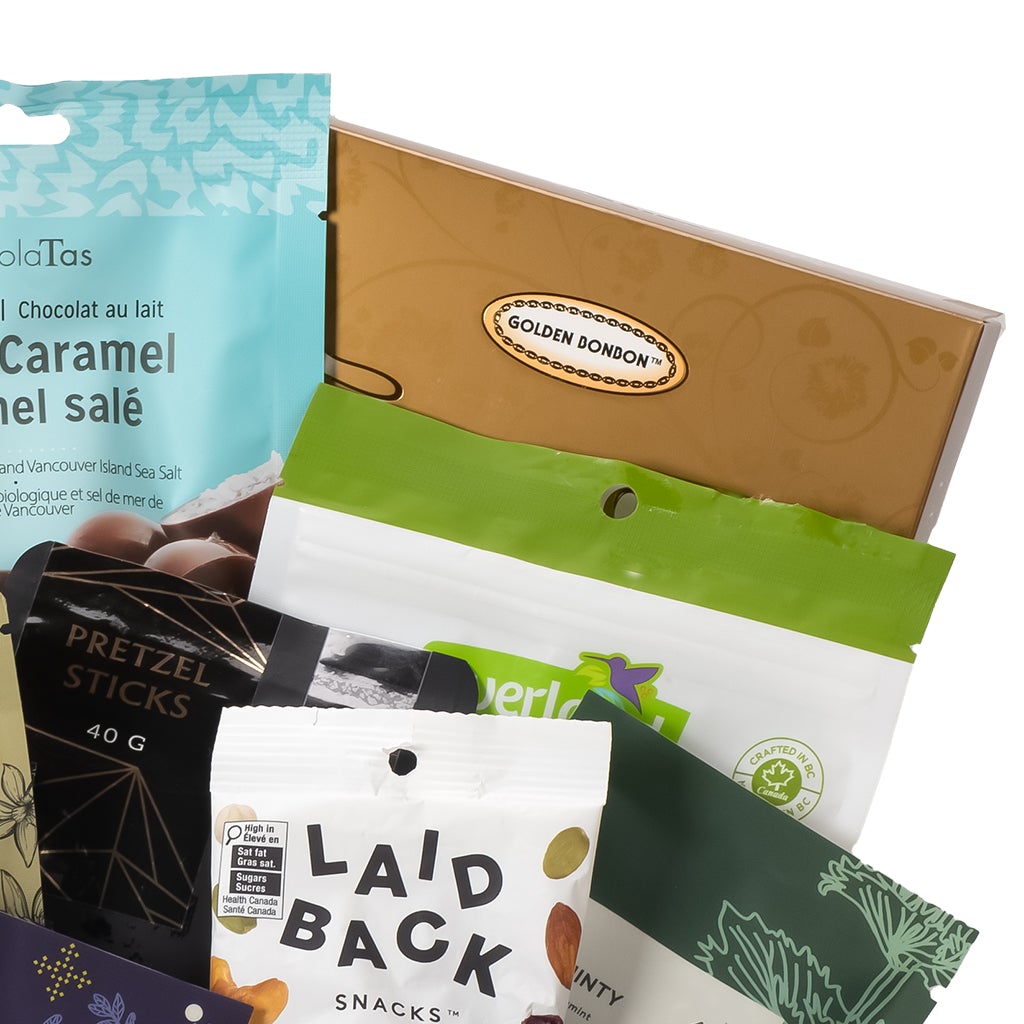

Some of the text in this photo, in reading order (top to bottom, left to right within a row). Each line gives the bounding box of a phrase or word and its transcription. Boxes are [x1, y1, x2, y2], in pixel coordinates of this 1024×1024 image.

[18, 299, 99, 319] Chocolat
[105, 304, 128, 319] au
[135, 299, 164, 318] lait
[508, 315, 574, 346] GOLDEN
[65, 386, 143, 428] salé
[26, 459, 97, 474] Vancouver
[99, 459, 132, 477] Island
[135, 462, 156, 479] Sea
[158, 464, 183, 480] Salt
[70, 488, 83, 501] et
[86, 487, 103, 502] sel
[105, 488, 121, 504] de
[122, 494, 146, 509] mer
[147, 494, 164, 510] de
[3, 503, 75, 517] Vancouver
[65, 623, 211, 688] PRETZEL
[63, 663, 192, 719] STICKS
[86, 724, 146, 751] 40 G
[749, 745, 816, 779] CRAFTED IN BC
[796, 797, 811, 812] BC
[243, 832, 266, 843] Élevé
[244, 824, 274, 834] High in
[237, 847, 267, 857] Sat fat
[237, 857, 276, 868] Gras sat.
[306, 823, 504, 910] LAID
[236, 872, 267, 883] Sugars
[236, 882, 266, 893] Sucres
[222, 895, 278, 906] Health Canada
[223, 904, 277, 916] Santé Canada
[279, 897, 513, 998] BACK
[573, 965, 624, 1007] INTY
